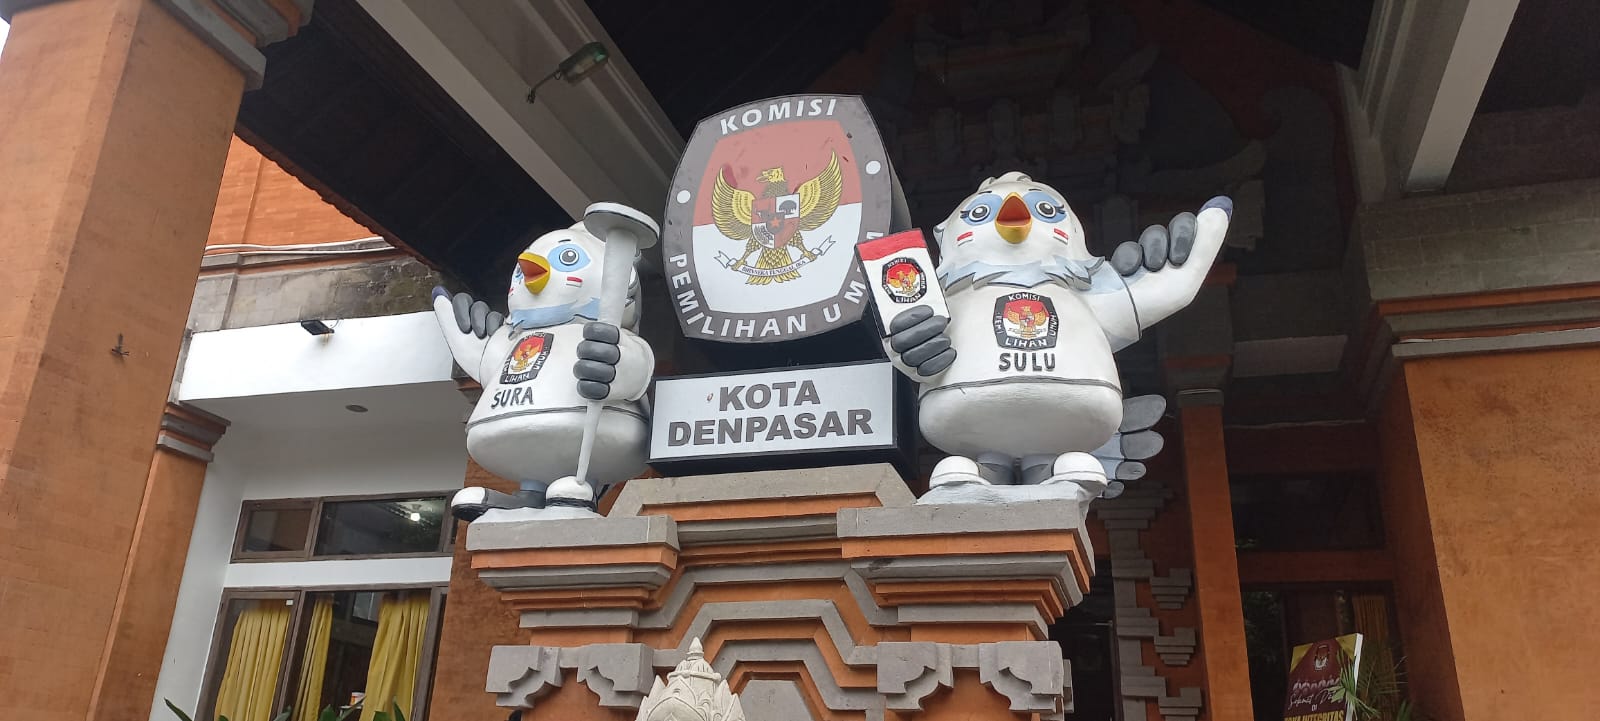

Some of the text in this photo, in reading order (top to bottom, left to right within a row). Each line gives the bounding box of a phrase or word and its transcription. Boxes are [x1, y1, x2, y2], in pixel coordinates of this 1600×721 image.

[720, 98, 837, 135] KOMISI
[669, 253, 807, 338] PEMILIHAN
[1008, 292, 1041, 302] KOMISI
[1005, 337, 1048, 348] LIHAN
[998, 352, 1056, 372] SULU
[491, 386, 534, 409] SURA
[719, 379, 821, 412] KOTA
[667, 409, 874, 447] DENPASAR
